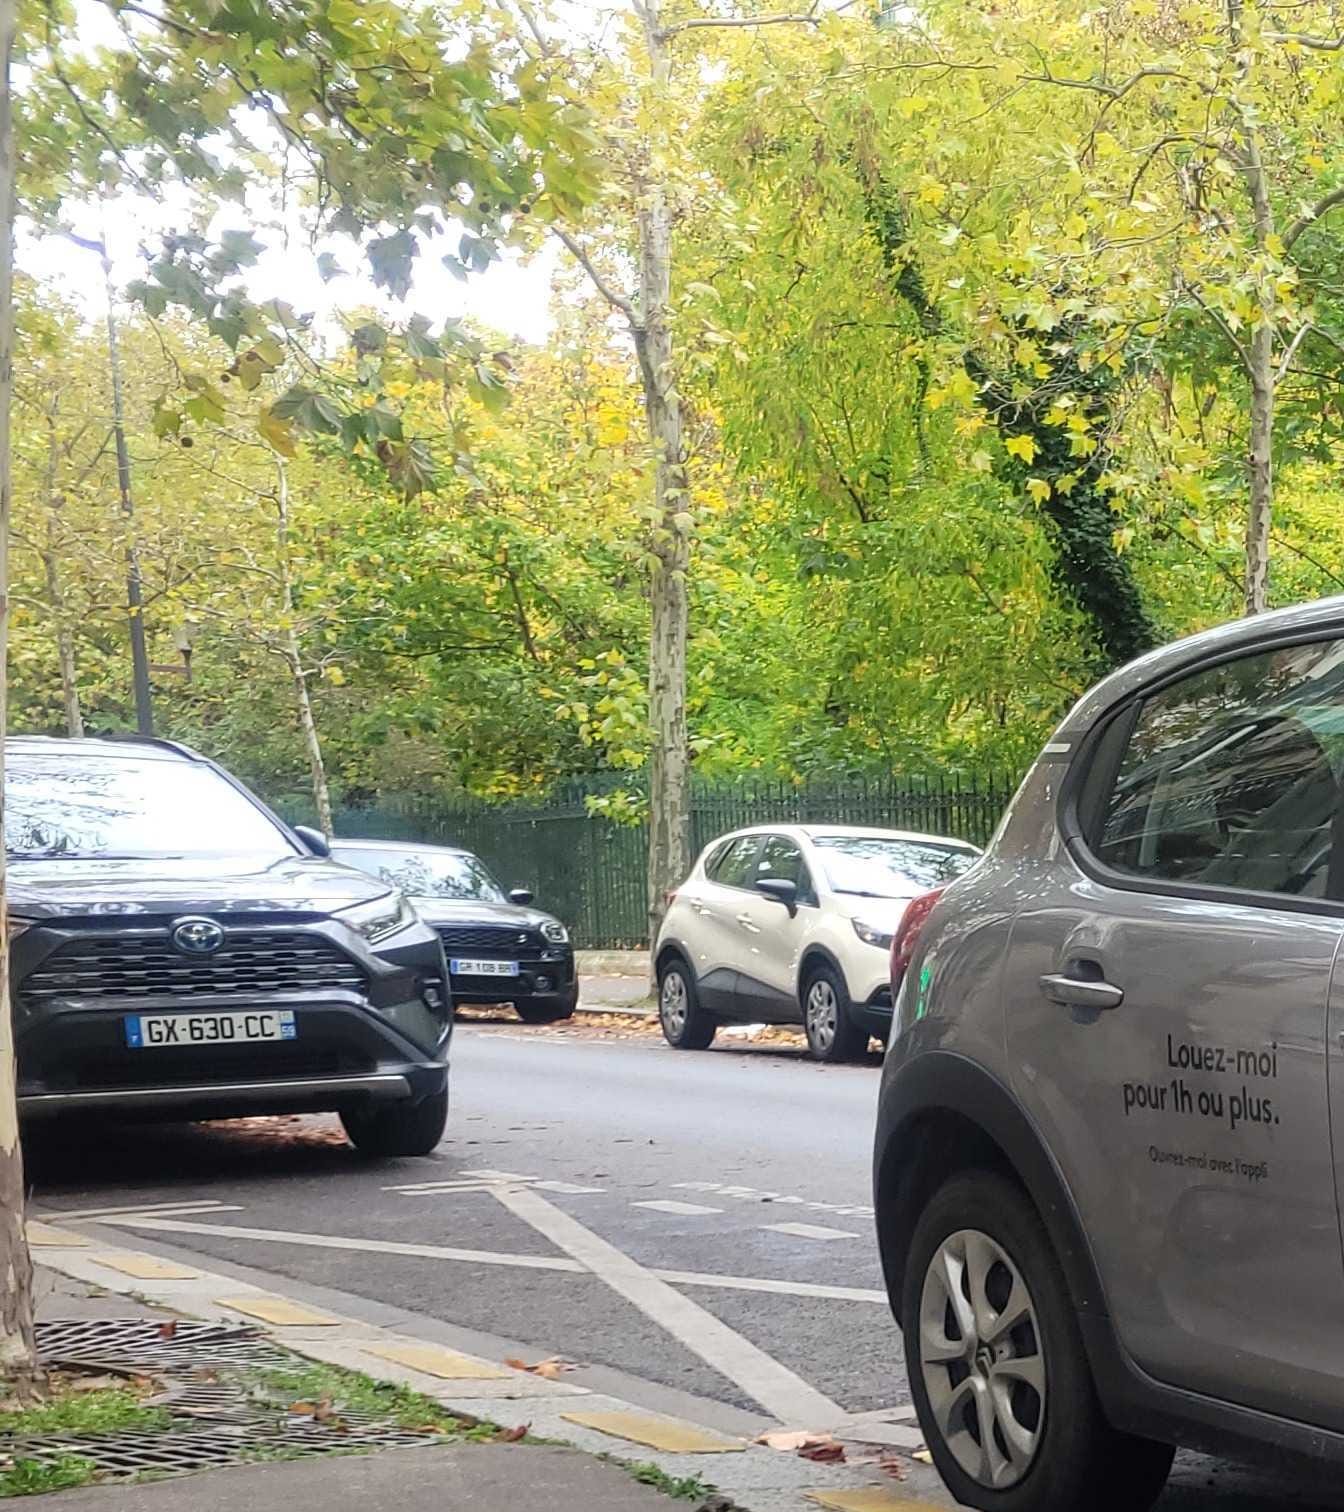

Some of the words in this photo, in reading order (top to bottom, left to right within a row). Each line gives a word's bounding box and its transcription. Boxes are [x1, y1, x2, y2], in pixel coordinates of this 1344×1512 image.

[147, 1014, 275, 1043] GX-630-CC
[1166, 1033, 1278, 1078] Louez-moi
[1122, 1082, 1168, 1116] pour
[1170, 1079, 1193, 1113] 1h
[1198, 1092, 1223, 1116] ou
[1229, 1086, 1280, 1129] plus.
